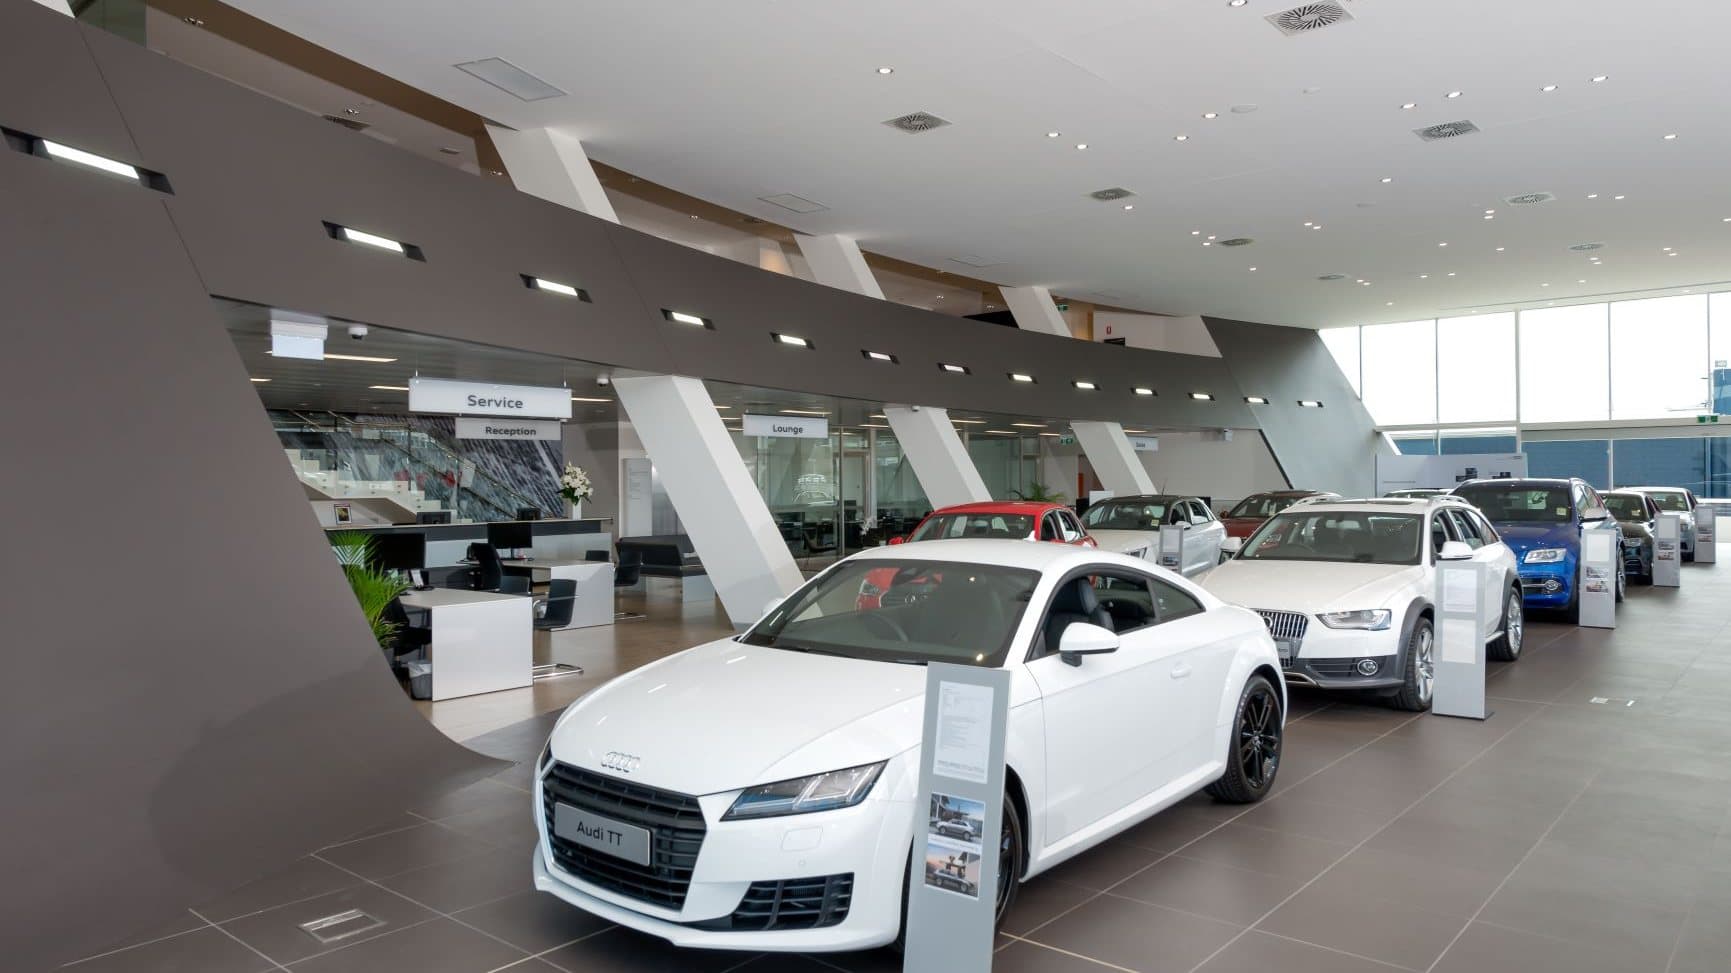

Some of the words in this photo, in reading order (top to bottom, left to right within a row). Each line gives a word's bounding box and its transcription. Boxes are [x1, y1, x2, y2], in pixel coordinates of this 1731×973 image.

[467, 394, 524, 409] Service
[485, 425, 537, 436] Reception
[772, 424, 804, 435] Lounge
[576, 821, 604, 841] Audi
[607, 830, 623, 847] TT
